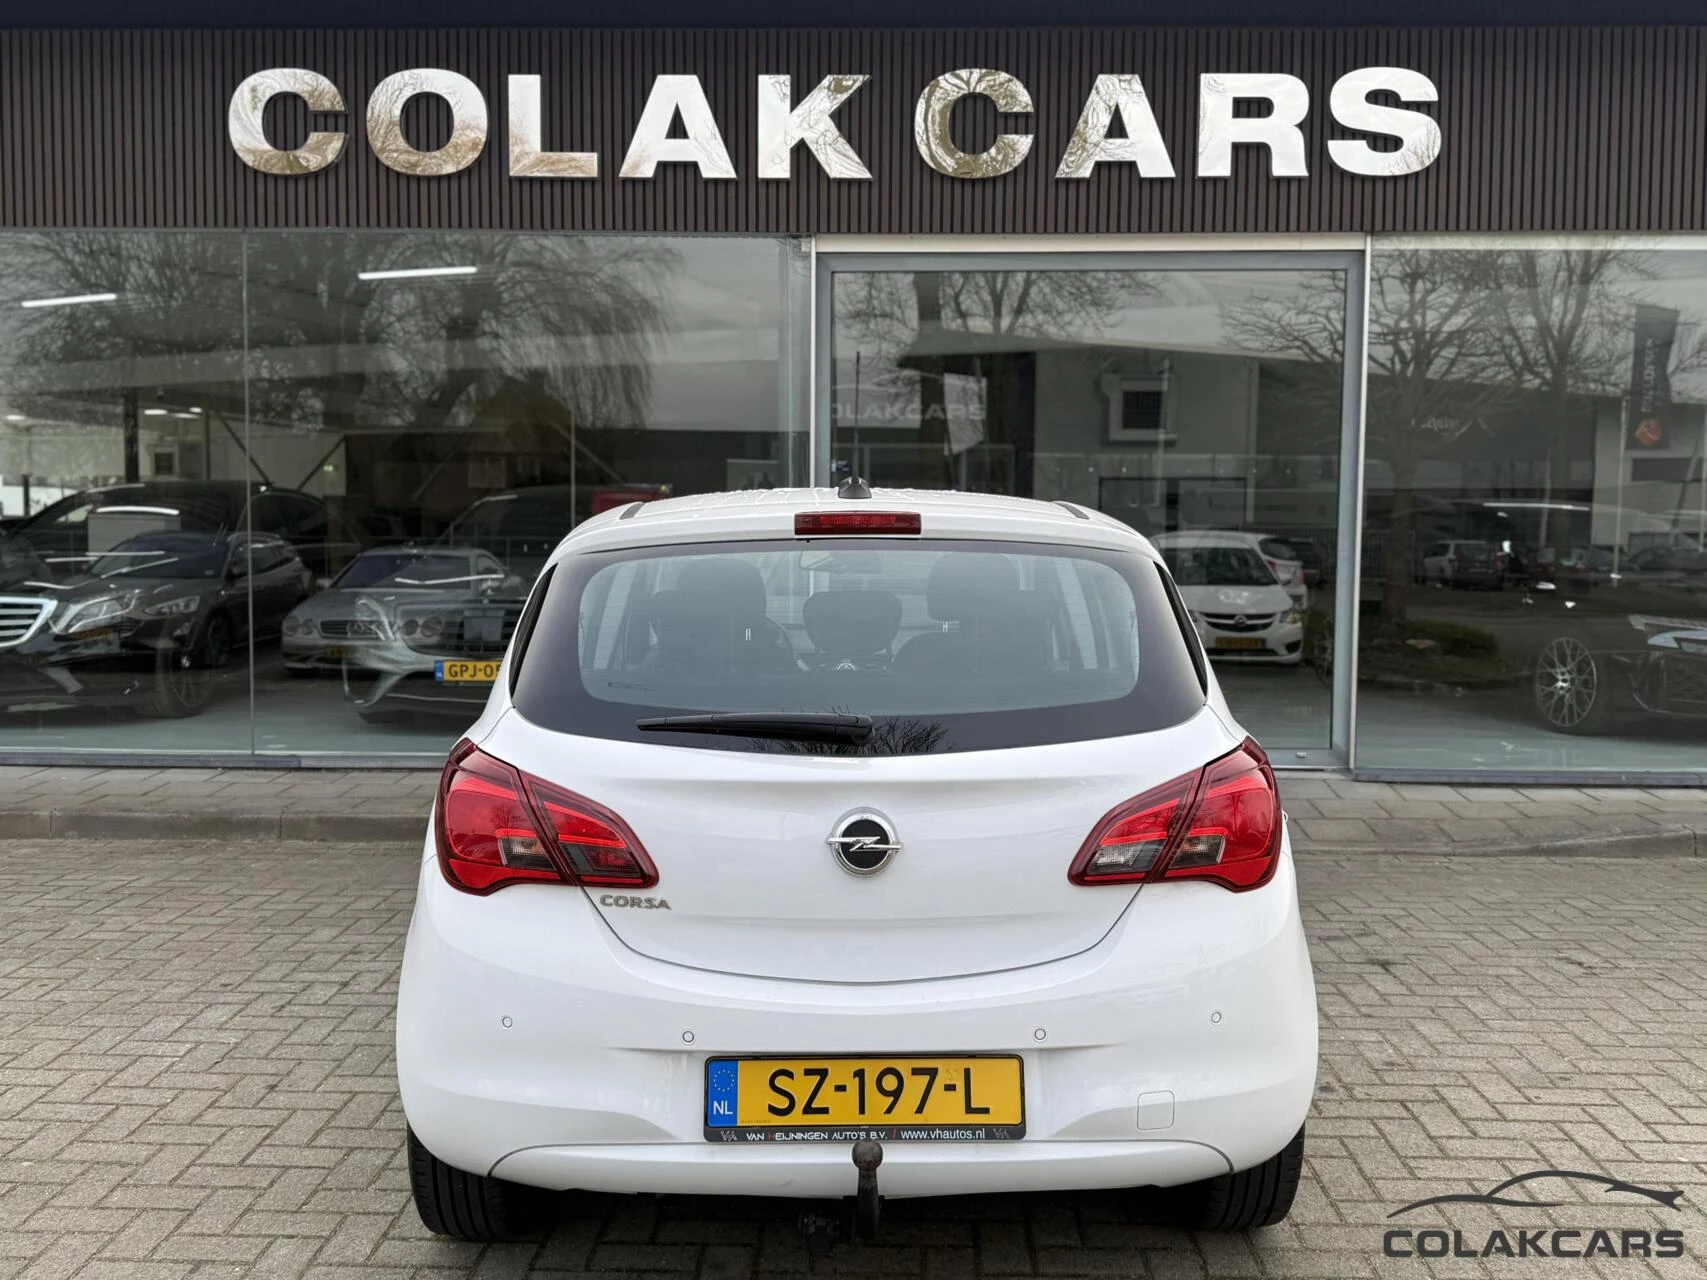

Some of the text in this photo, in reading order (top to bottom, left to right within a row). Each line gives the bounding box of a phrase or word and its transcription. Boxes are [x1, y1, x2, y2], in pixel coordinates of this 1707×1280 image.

[228, 66, 1442, 180] COLAK CARS
[600, 894, 671, 910] CORSA
[767, 1067, 991, 1117] SZ-197-L
[713, 1101, 733, 1115] NL
[746, 1132, 765, 1141] VAN
[831, 1130, 867, 1140] AUTO'S
[870, 1130, 888, 1140] B.V.
[900, 1128, 986, 1140] www.vhautos.nl
